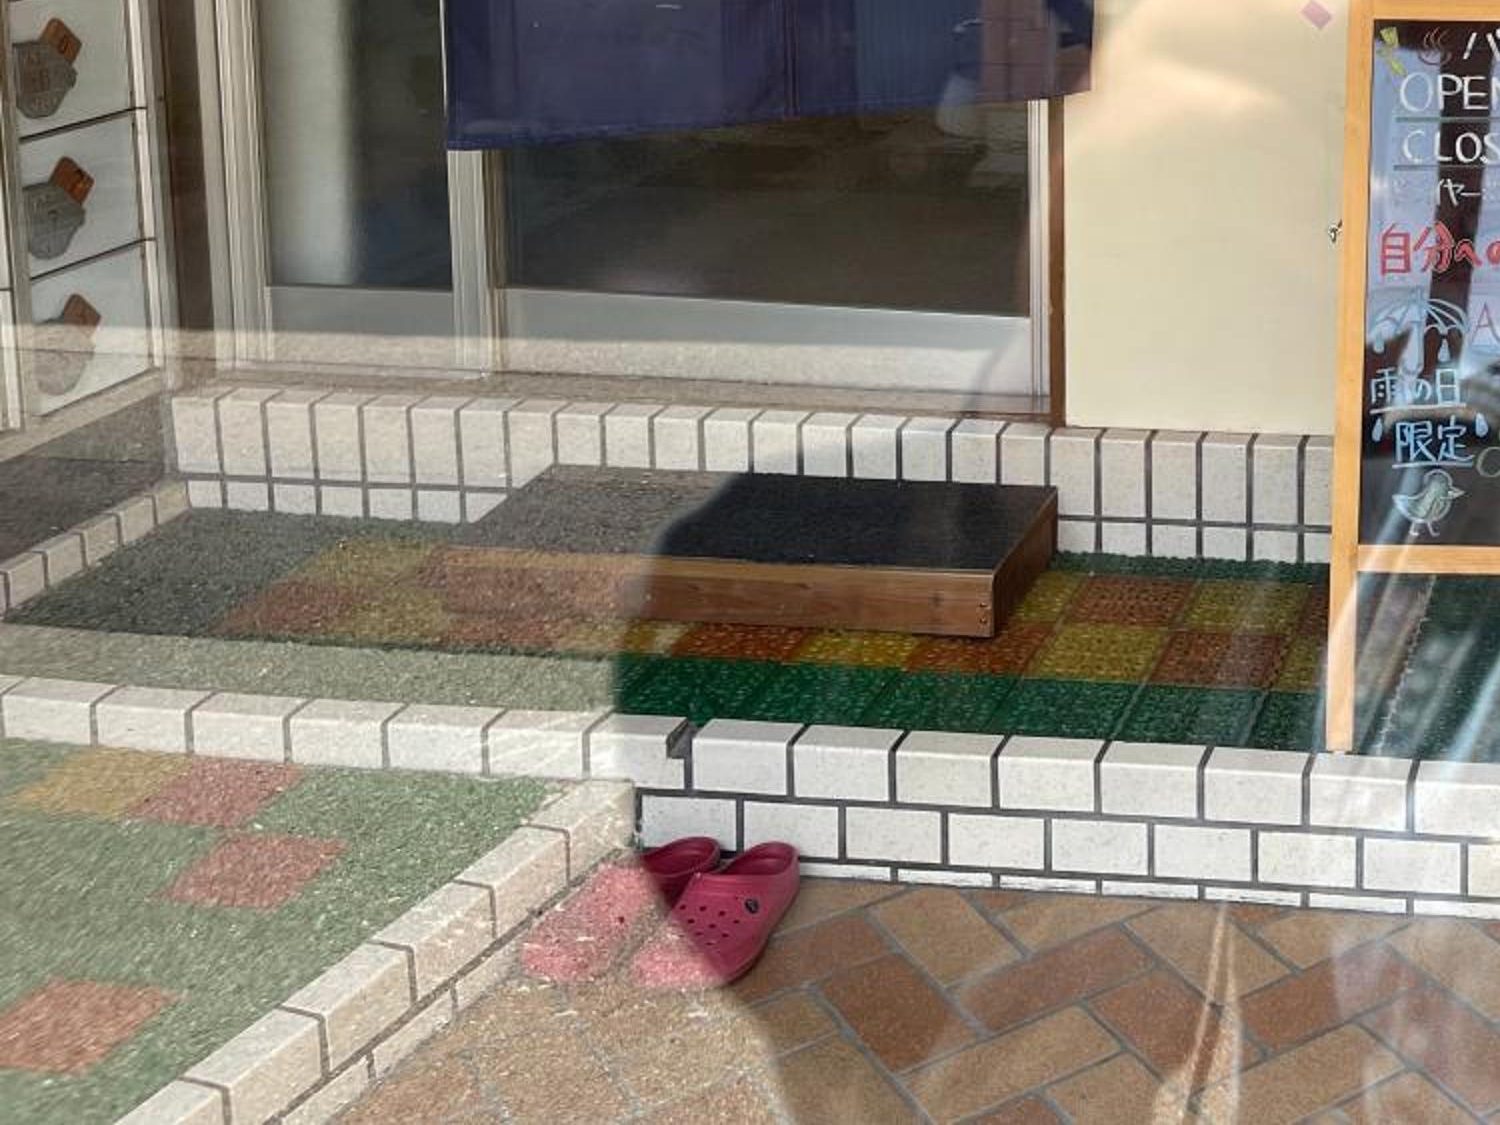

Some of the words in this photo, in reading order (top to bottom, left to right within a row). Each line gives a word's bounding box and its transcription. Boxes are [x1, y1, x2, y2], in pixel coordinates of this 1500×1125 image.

[1370, 368, 1461, 406] 雨の日
[1394, 420, 1468, 465] 限定
